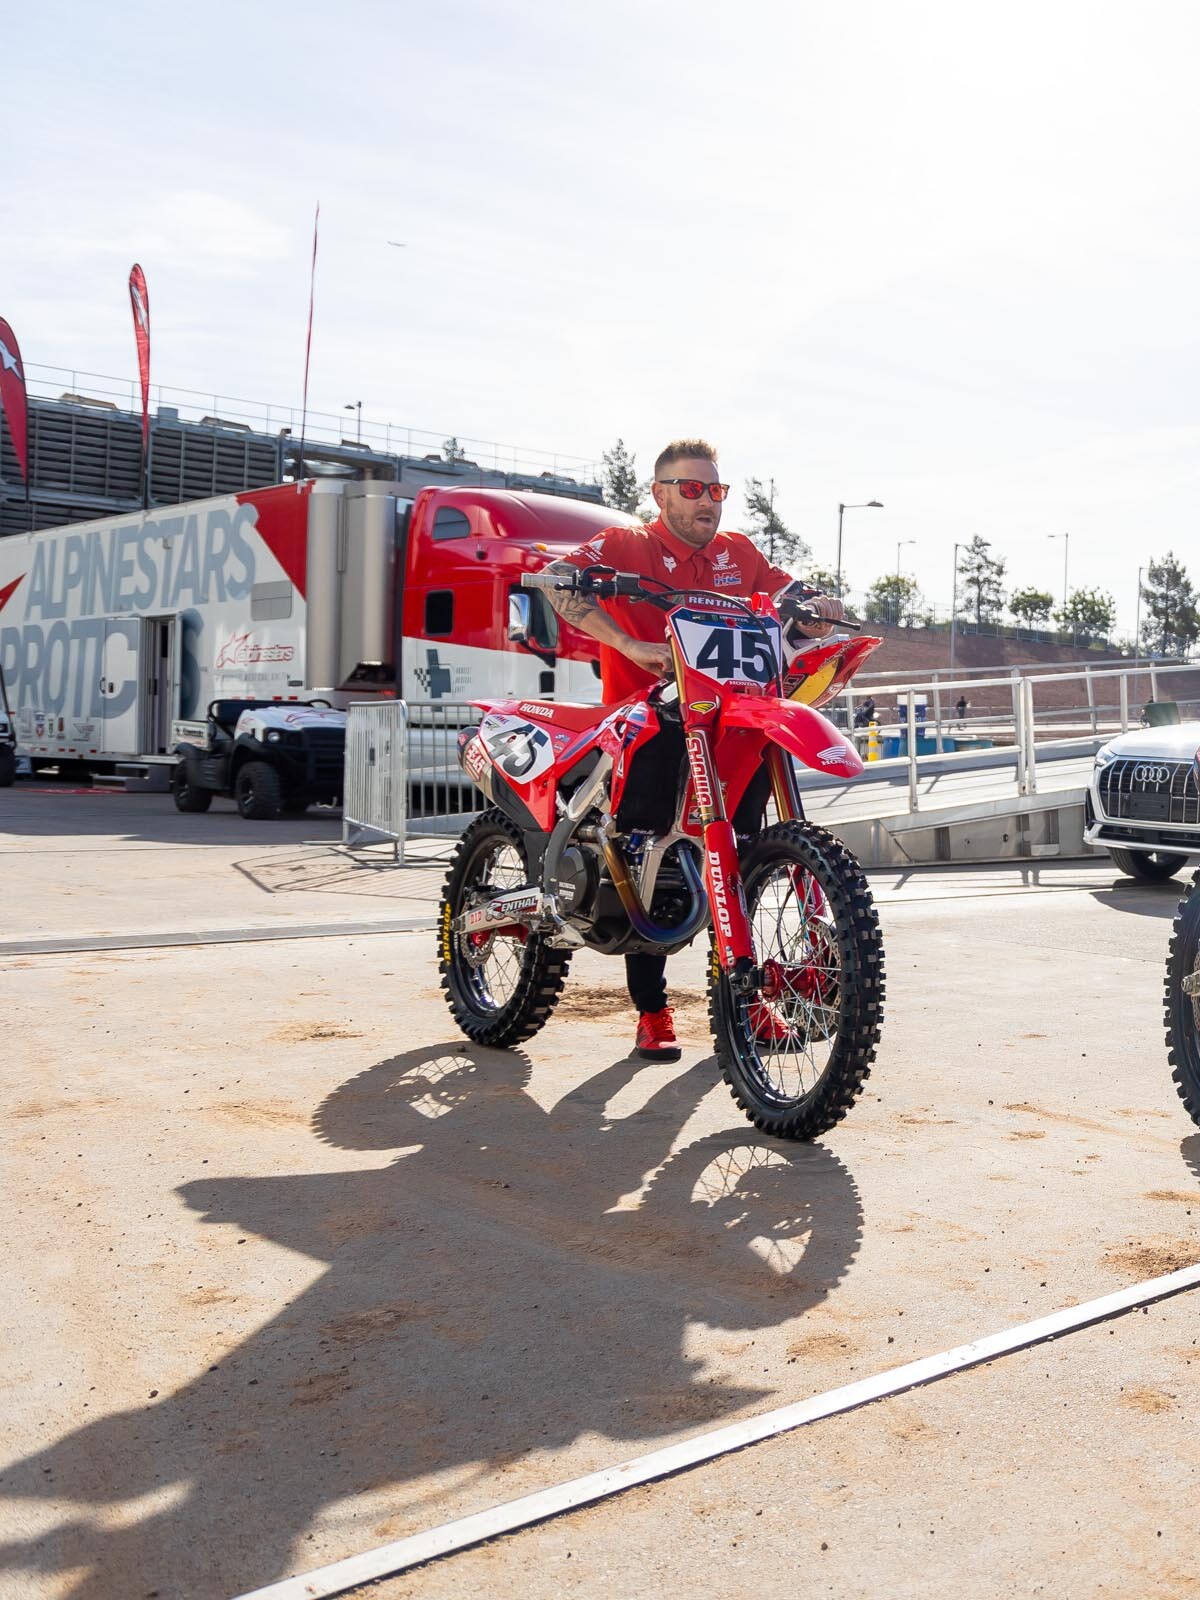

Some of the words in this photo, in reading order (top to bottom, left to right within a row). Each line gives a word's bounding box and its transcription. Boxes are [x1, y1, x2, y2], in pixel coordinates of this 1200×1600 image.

[24, 502, 259, 621] ALPINESTARS
[688, 596, 741, 610] RENTHA
[695, 628, 777, 683] 45
[519, 703, 555, 718] HONDA
[489, 723, 549, 777] 45
[686, 738, 713, 808] SHOWA
[709, 850, 732, 938] DUNLOP
